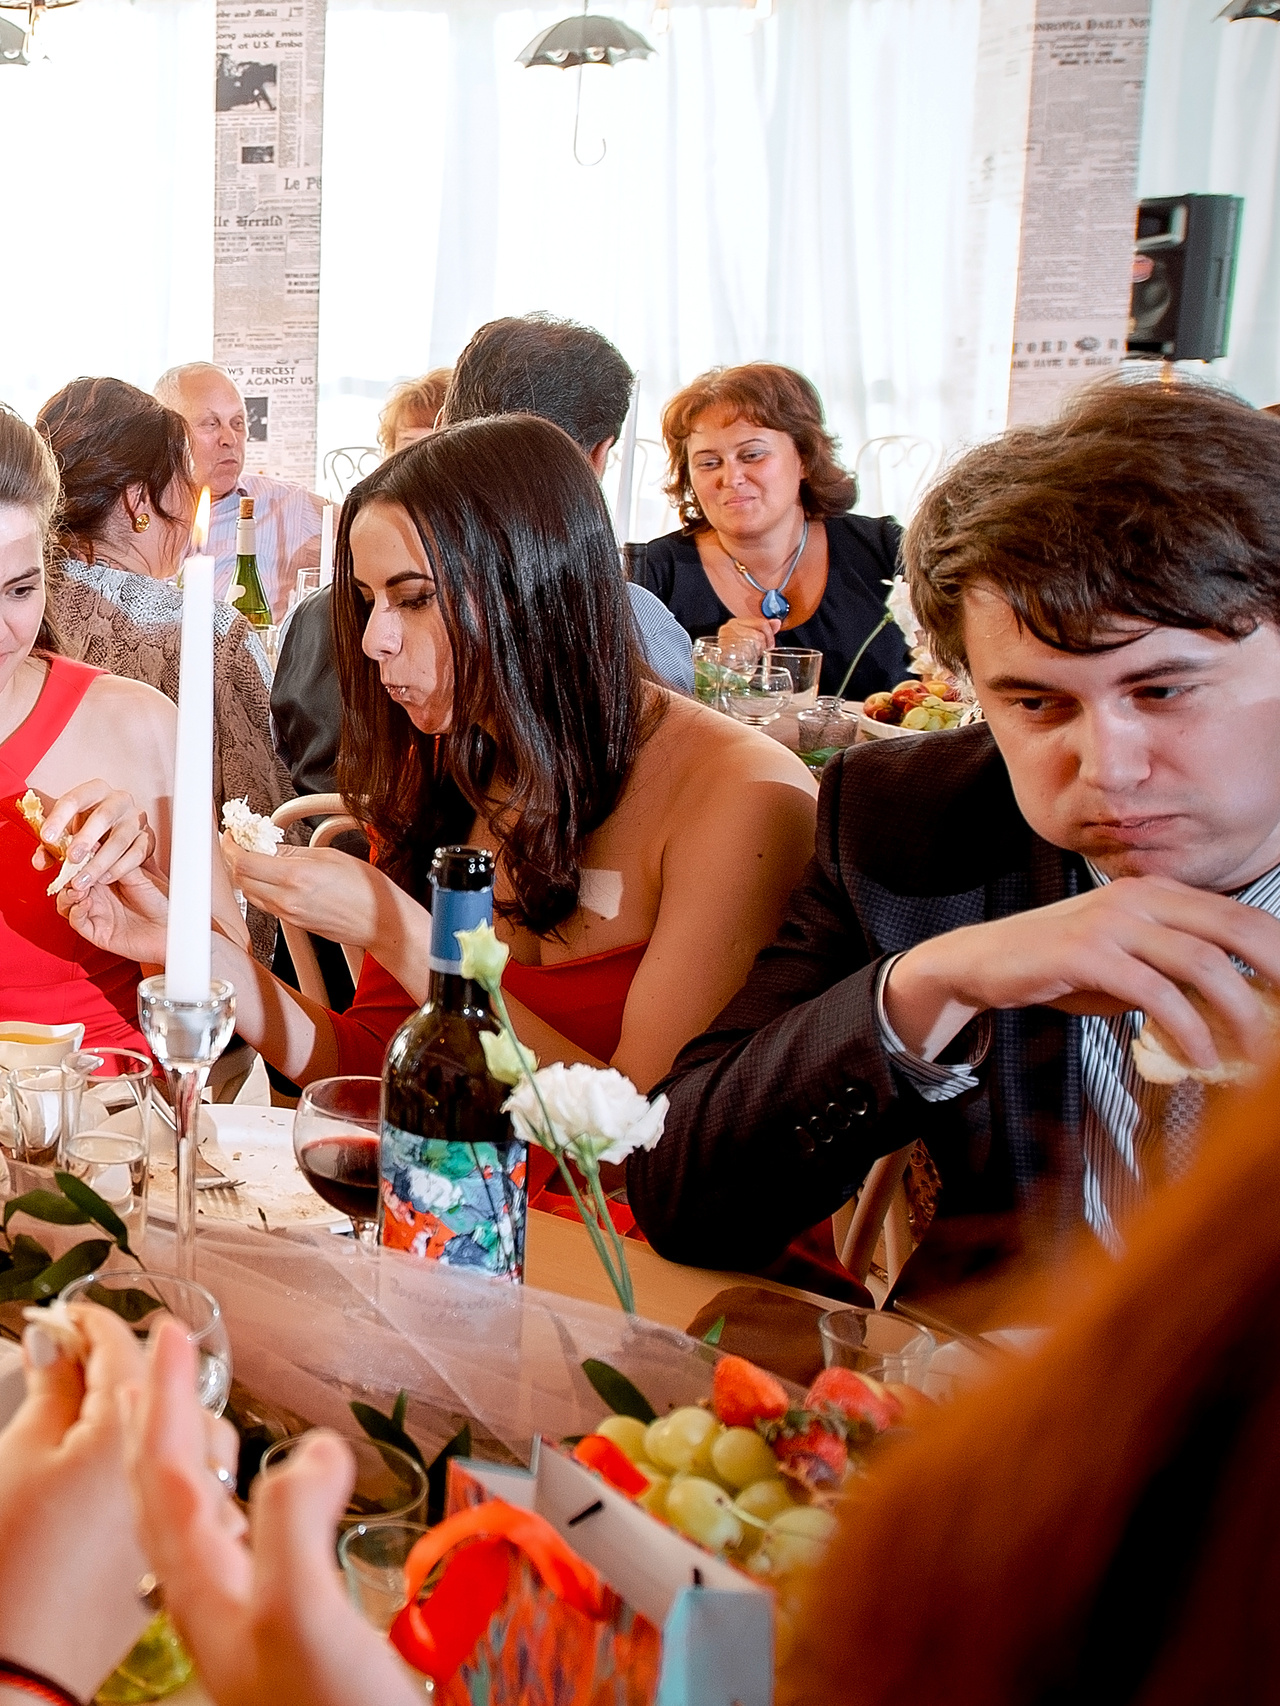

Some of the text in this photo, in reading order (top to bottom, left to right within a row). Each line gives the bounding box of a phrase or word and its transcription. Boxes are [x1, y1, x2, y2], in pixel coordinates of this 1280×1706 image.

[243, 29, 275, 39] suicide
[284, 177, 300, 191] Le
[235, 215, 283, 229] Herald
[251, 366, 297, 376] FIERCEST
[246, 376, 295, 386] AGAINST
[300, 376, 315, 386] US
